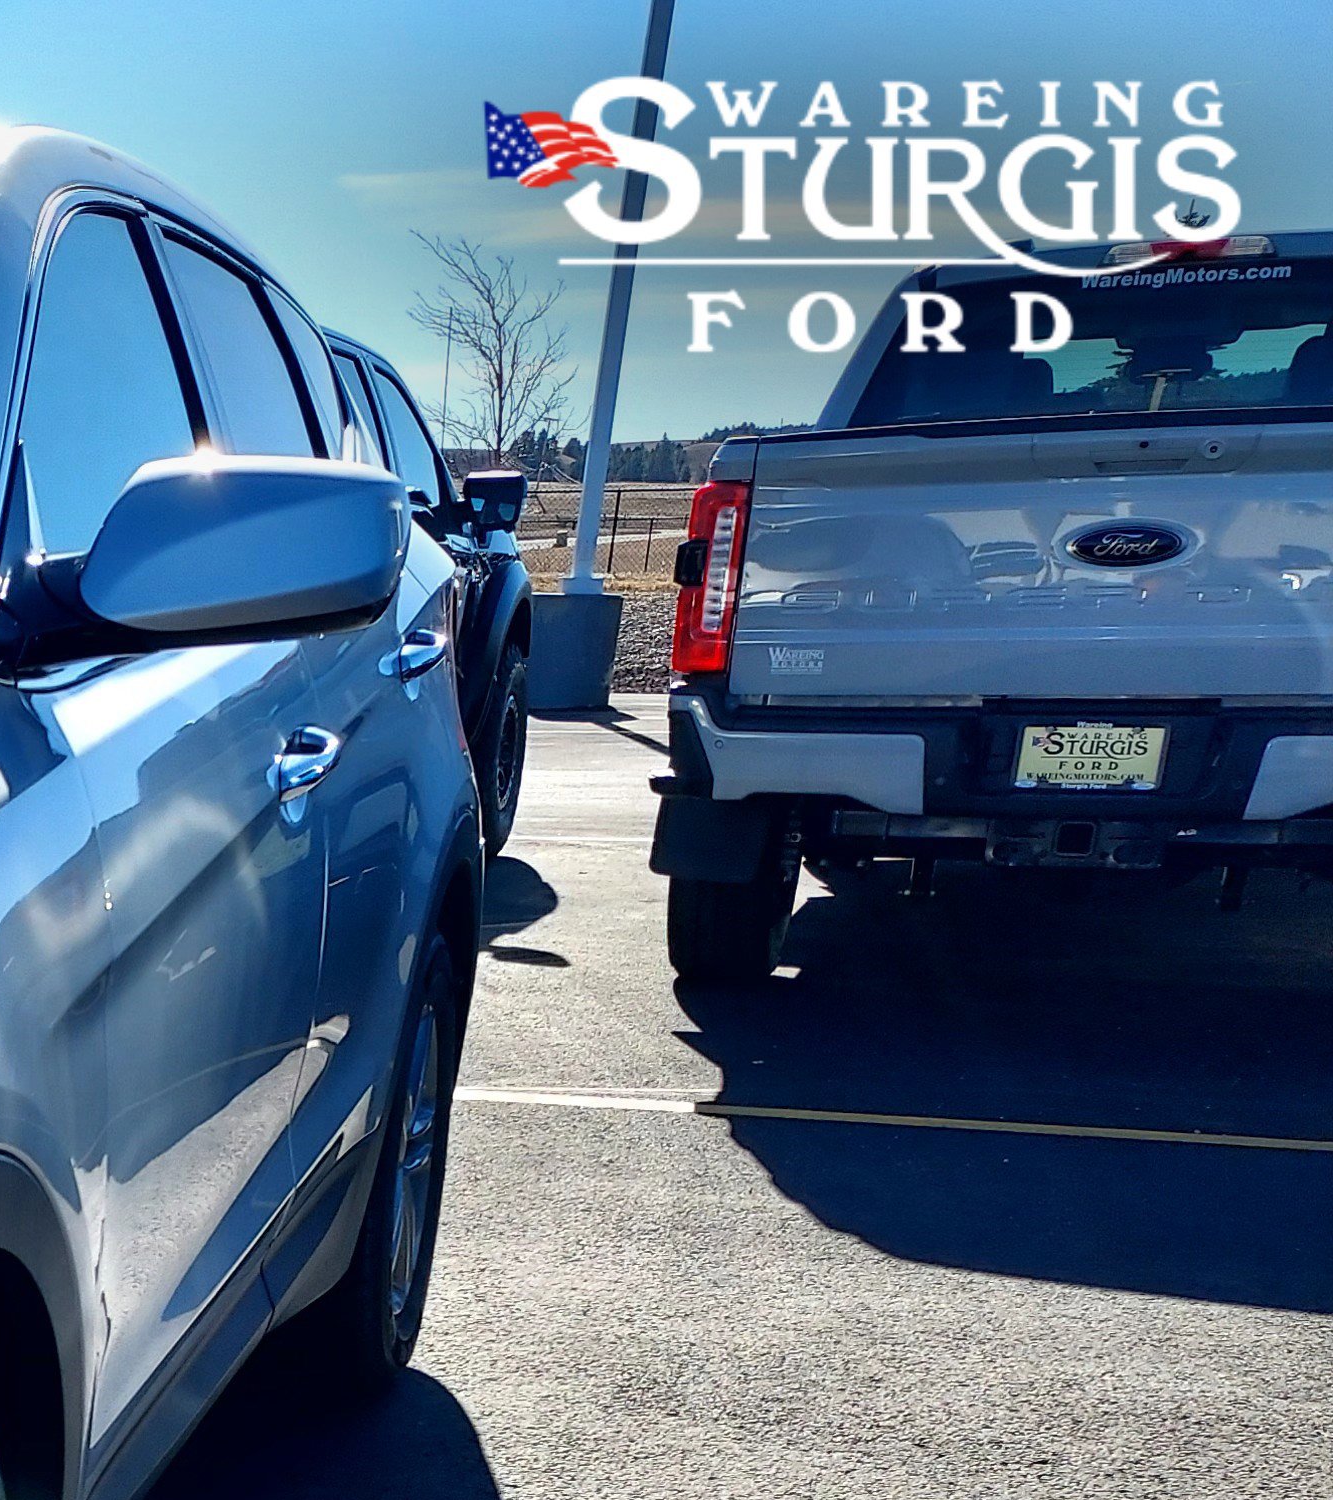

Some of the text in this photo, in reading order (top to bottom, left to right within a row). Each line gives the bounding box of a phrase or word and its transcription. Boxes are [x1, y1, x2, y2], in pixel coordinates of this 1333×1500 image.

[1082, 266, 1292, 288] WareingMotors.com
[1093, 533, 1159, 556] Ford
[1043, 732, 1149, 760] STURGIS
[1067, 732, 1148, 740] WAREING
[1058, 761, 1119, 771] FORD
